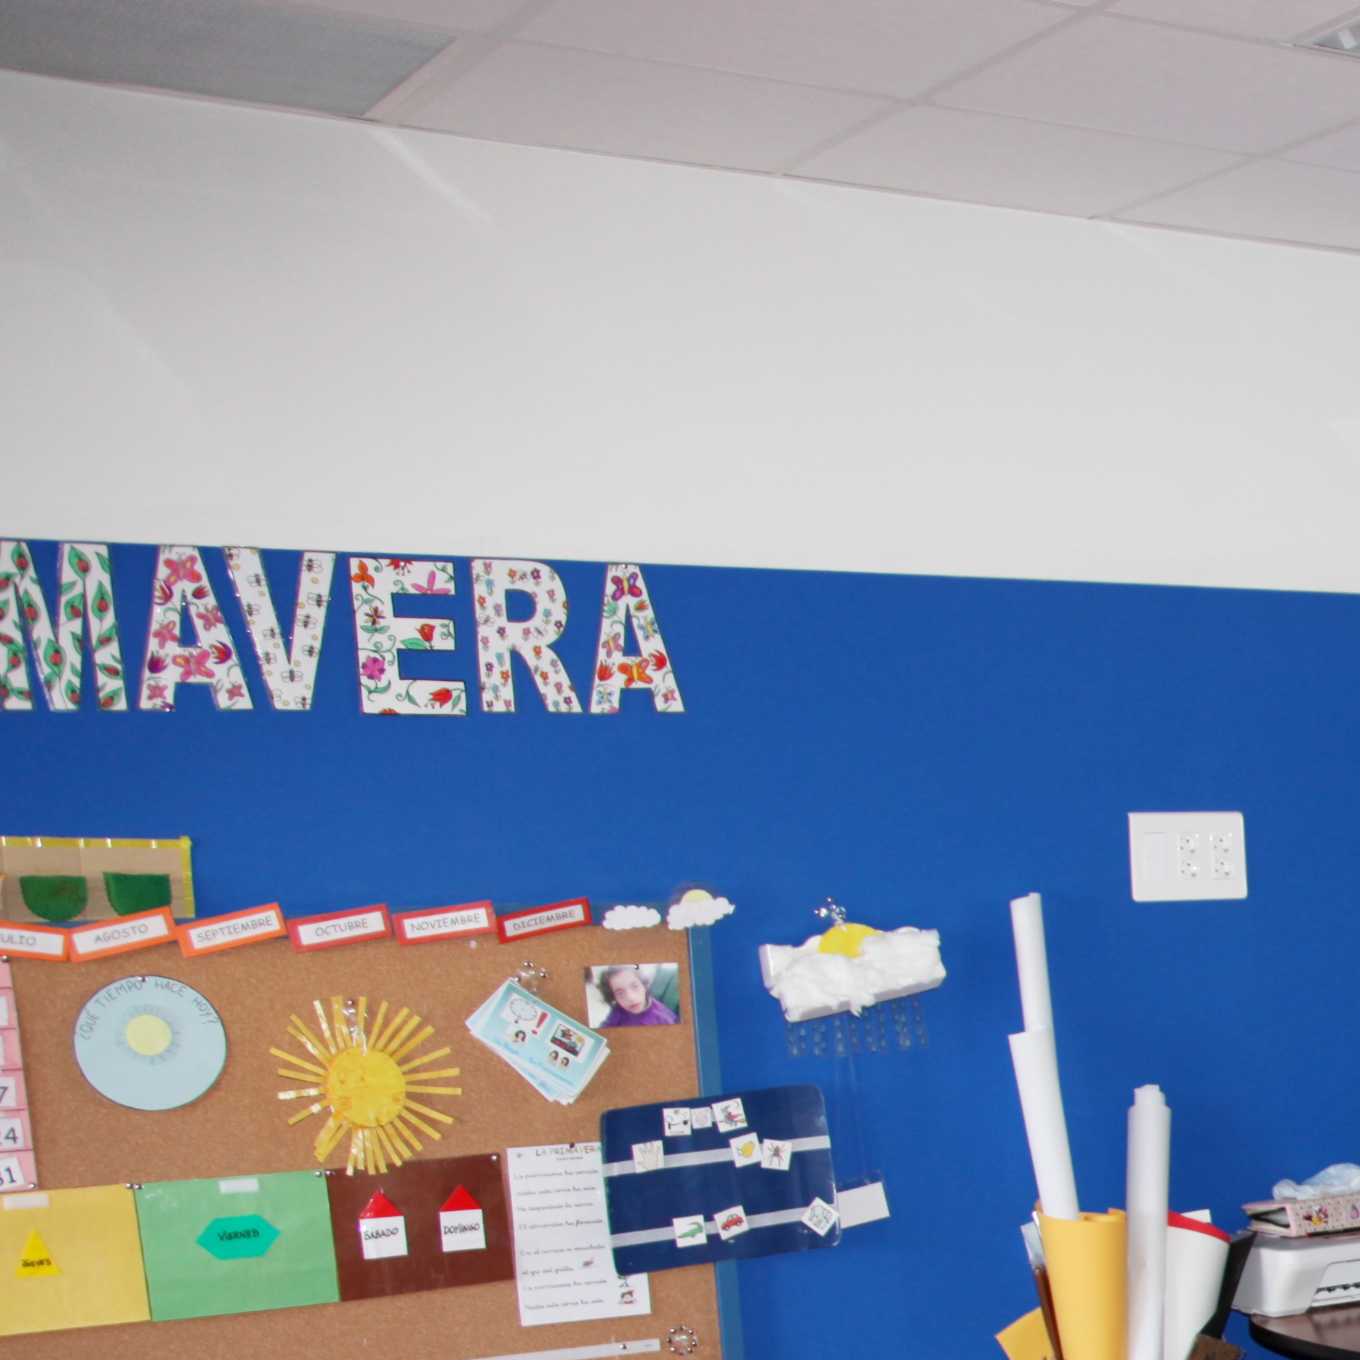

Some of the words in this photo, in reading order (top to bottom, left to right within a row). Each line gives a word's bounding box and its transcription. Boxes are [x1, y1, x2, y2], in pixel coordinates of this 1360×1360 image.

[196, 915, 274, 942] SEPTIEMBRE
[315, 918, 369, 937] OCTUBRE
[410, 913, 482, 933] NOVIEMBRE
[512, 909, 577, 931] DICIEMBRE
[94, 923, 149, 944] AGOSTO
[94, 980, 144, 1008] TIEMPO
[153, 980, 188, 998] HACE
